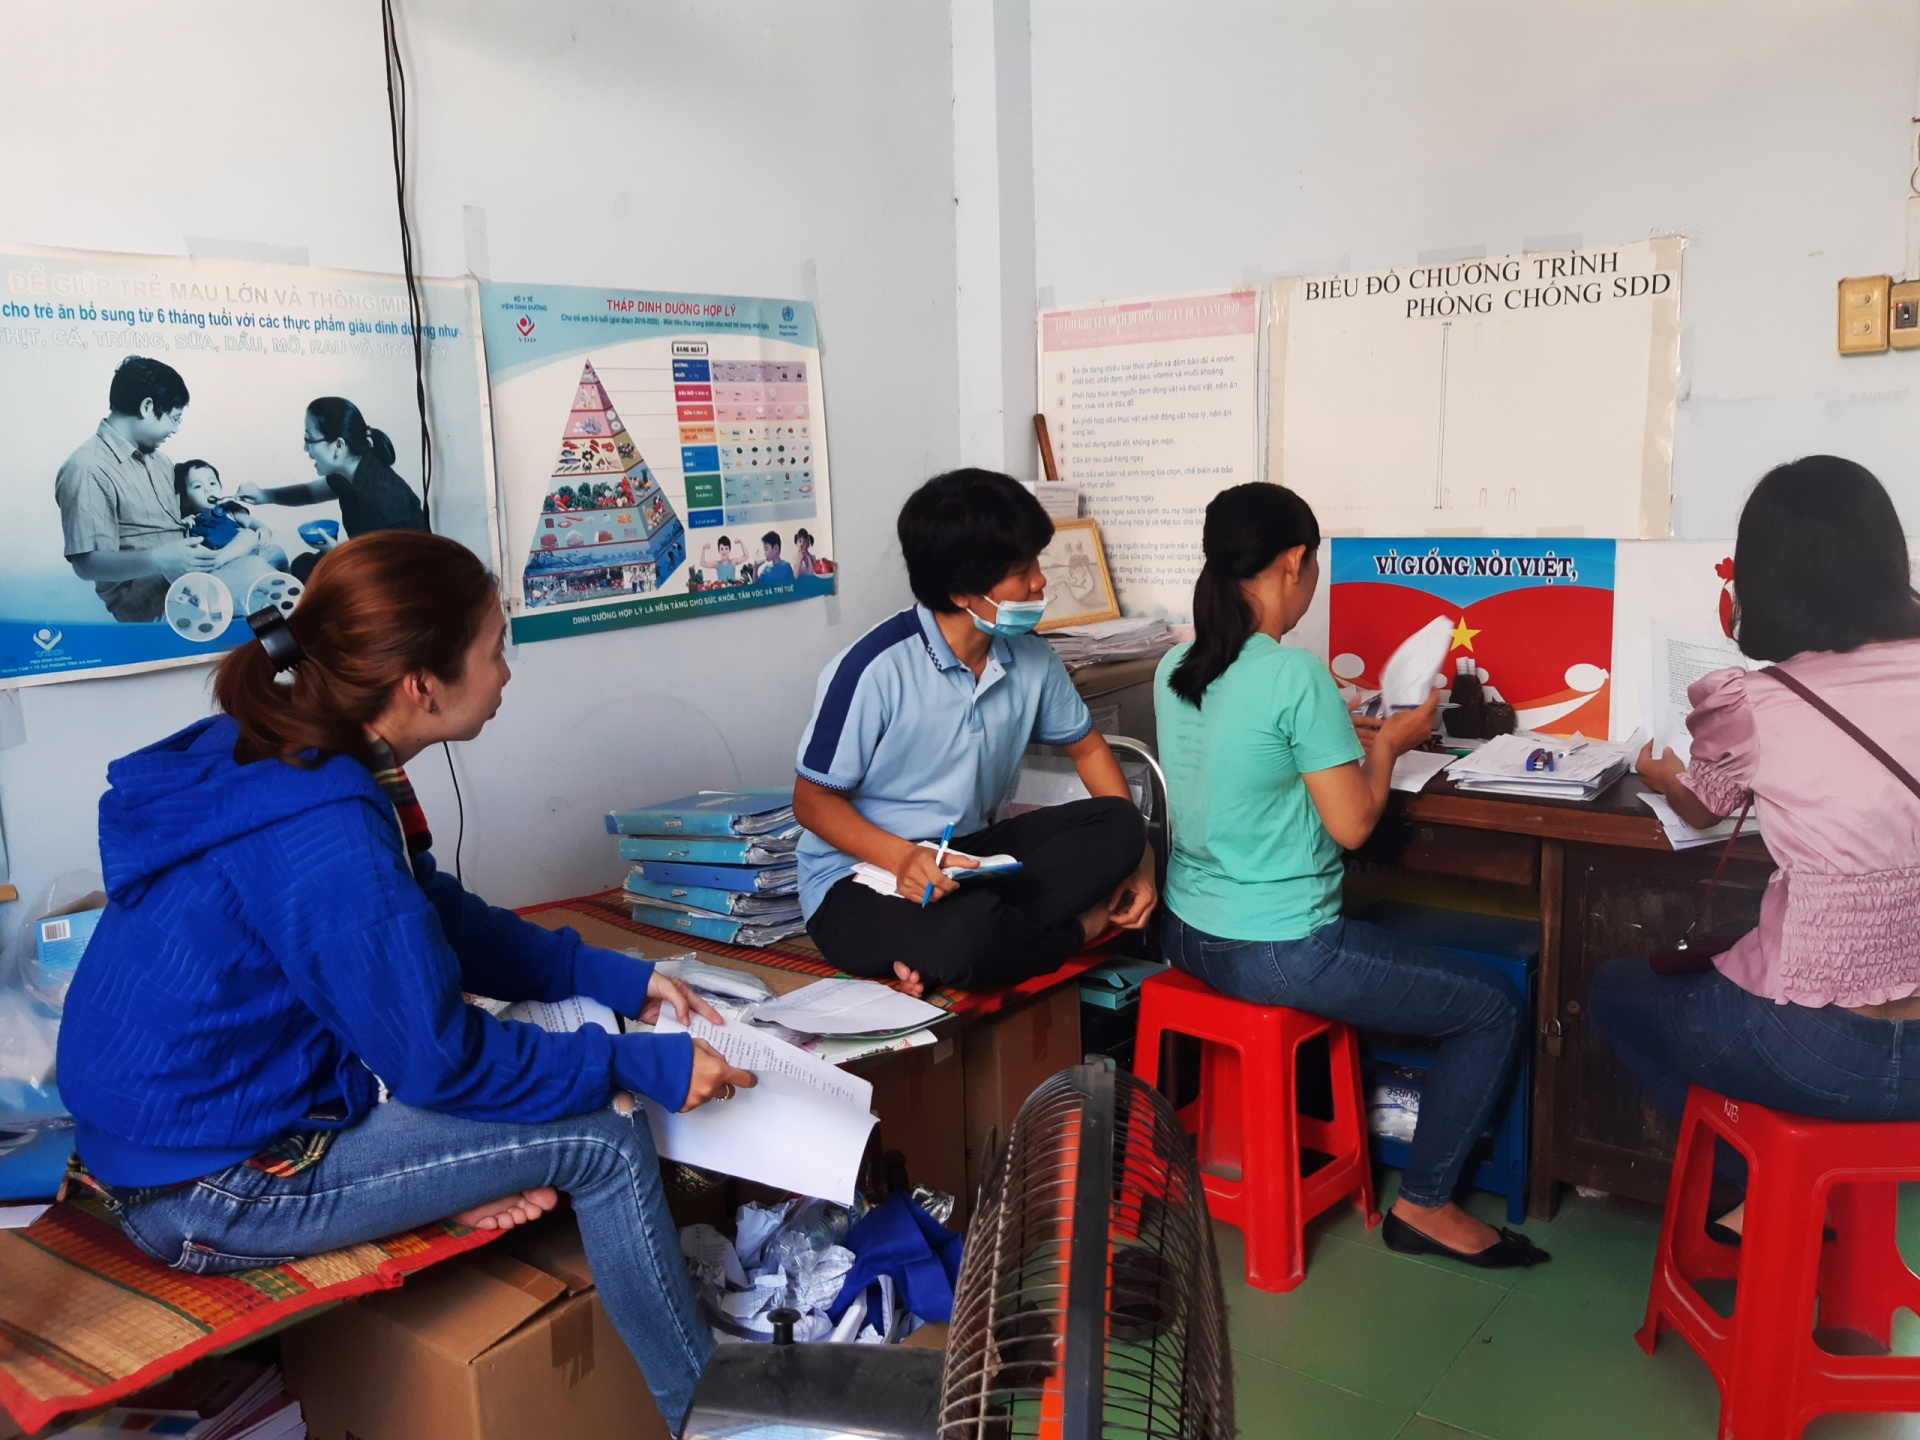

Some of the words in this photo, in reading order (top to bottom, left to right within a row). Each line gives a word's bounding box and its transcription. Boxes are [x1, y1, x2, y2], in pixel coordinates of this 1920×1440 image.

[1409, 260, 1520, 290] CHƯƠNG
[1533, 250, 1620, 280] TRÌNH
[169, 282, 218, 302] MAU
[225, 282, 268, 304] LỚN
[273, 285, 302, 307] VÀ
[307, 288, 375, 311] THÔNG
[606, 297, 635, 312] THÁP
[637, 300, 662, 314] DINH
[665, 300, 701, 316] DƯỠNG
[703, 303, 722, 318] HỢP
[724, 302, 737, 318] LÝ
[1405, 291, 1493, 318] PHÒNG
[1503, 281, 1603, 310] CHỐNG
[1612, 273, 1671, 298] SDD
[2, 301, 29, 318] cho
[34, 301, 53, 319] trẻ
[58, 303, 75, 320] ăn
[79, 300, 97, 321] bổ
[101, 309, 135, 326] sung
[139, 306, 154, 323] từ
[157, 308, 165, 323] 6
[168, 308, 205, 329] tháng
[208, 307, 232, 326] tuổi
[235, 313, 255, 327] với
[258, 314, 279, 329] các
[283, 315, 310, 333] thực
[313, 313, 345, 335] phẩm
[348, 318, 371, 336] giàu
[375, 320, 397, 335] dinh
[437, 323, 459, 338] như
[92, 327, 170, 351] TRỨNG,
[174, 329, 220, 353] SỮA,
[224, 331, 268, 354] DẦU,
[272, 334, 304, 357] MỠ,
[309, 338, 346, 355] RAU
[350, 338, 374, 356] VÀ
[1374, 547, 1400, 577] VÌ
[1400, 547, 1470, 577] GIỐNG
[1472, 550, 1513, 578] NÒI
[1514, 551, 1578, 586] VIỆT,
[572, 616, 590, 625] DINH
[591, 611, 616, 622] DƯỠNG
[617, 608, 632, 619] HỢP
[634, 605, 643, 615] LÝ
[644, 604, 654, 614] LÀ
[656, 601, 669, 612] NỀN
[670, 600, 688, 610] TẢNG
[689, 598, 703, 607] CHO
[703, 596, 716, 605] SỨC
[751, 589, 762, 598] VÓC
[765, 587, 773, 596] VÀ
[1385, 1087, 1420, 1102] NURSE
